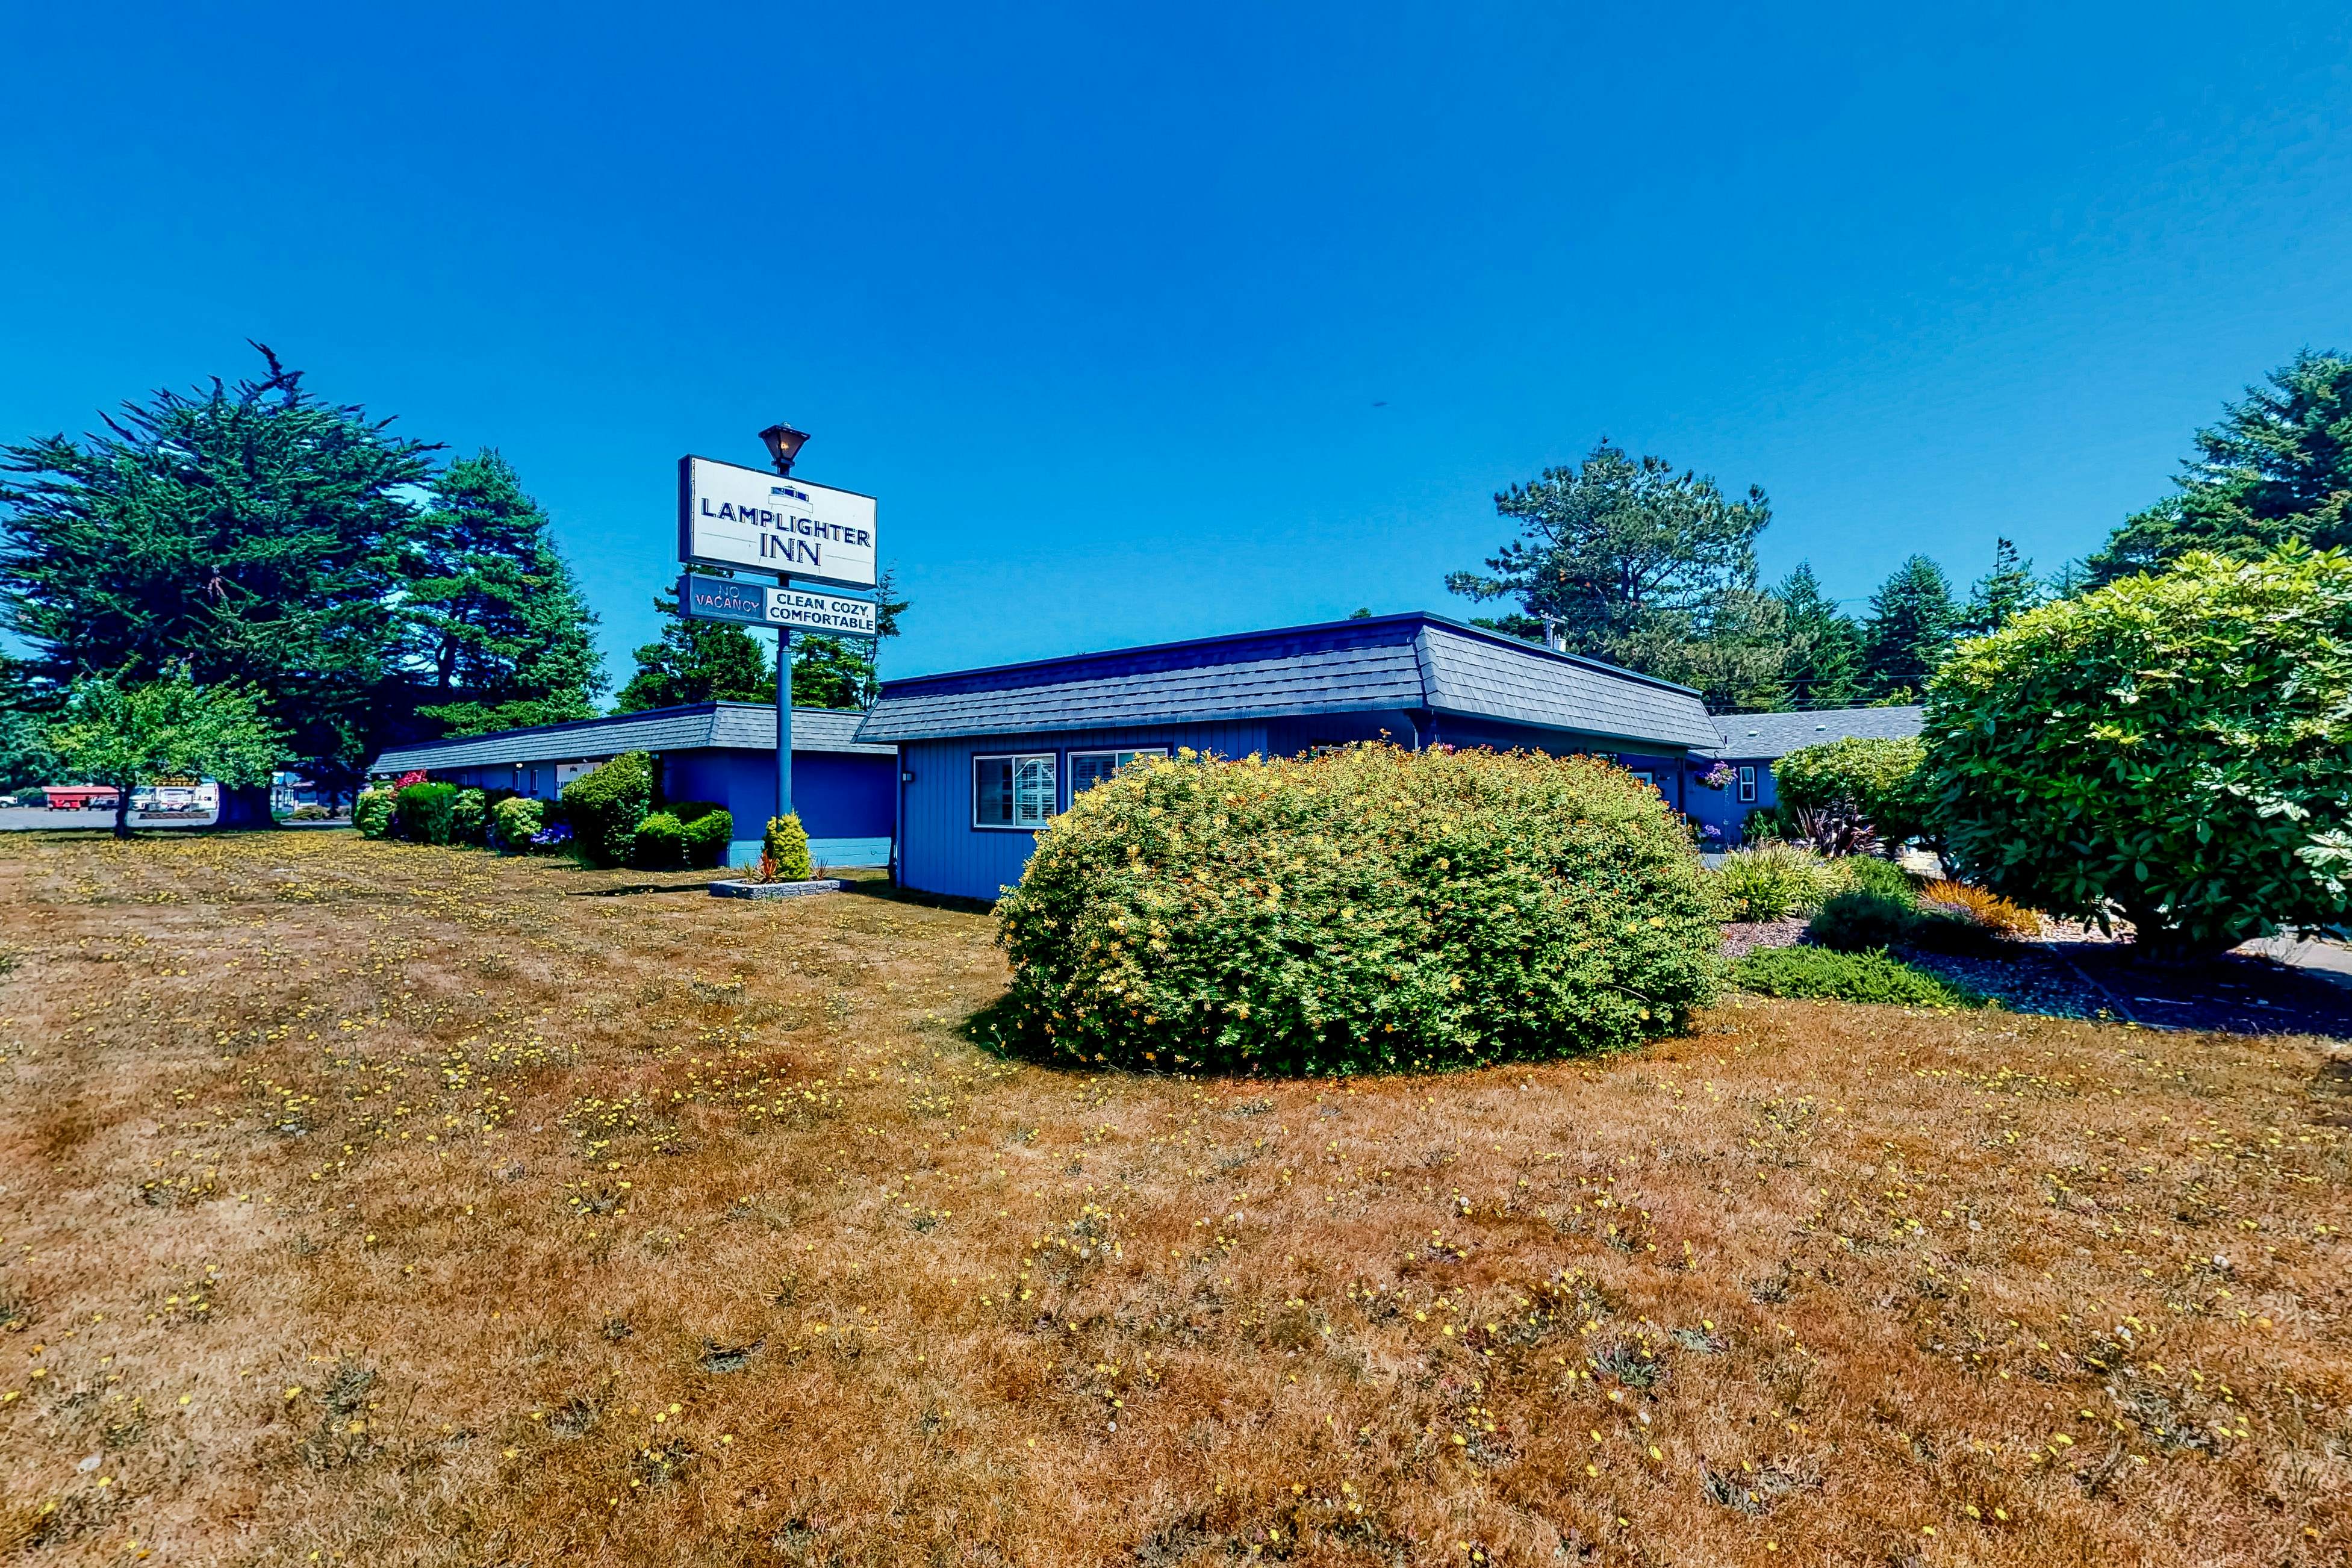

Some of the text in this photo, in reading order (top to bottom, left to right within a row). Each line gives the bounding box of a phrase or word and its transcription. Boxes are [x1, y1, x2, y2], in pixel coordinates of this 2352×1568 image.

[701, 498, 871, 547] LAMPLIGHTER
[760, 533, 821, 566] INN
[718, 585, 739, 597] NO
[695, 594, 759, 612] VACANCY
[777, 594, 868, 617] CLEAN, COZY,
[770, 607, 873, 630] COMFORTABLE
